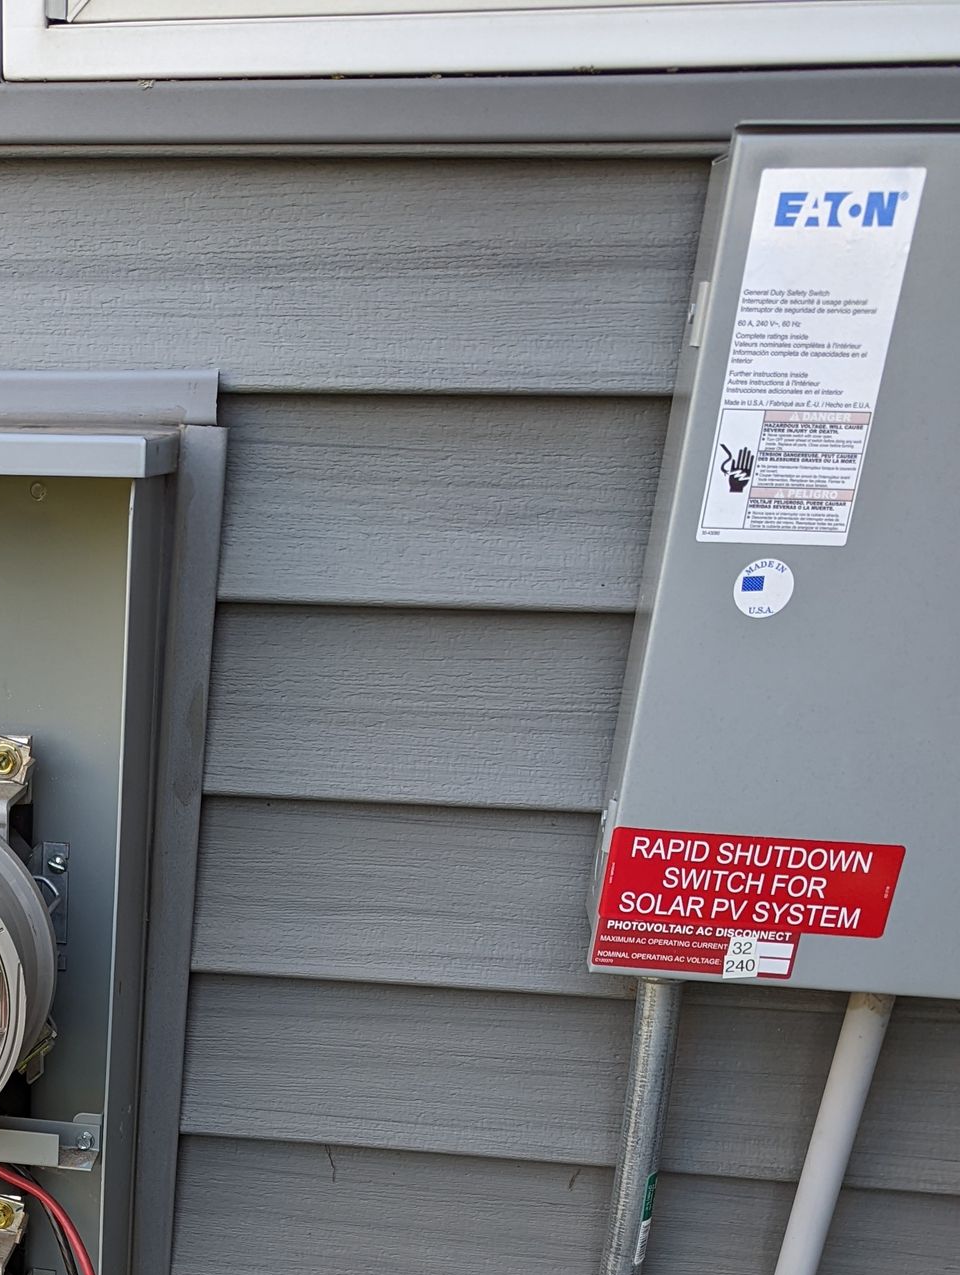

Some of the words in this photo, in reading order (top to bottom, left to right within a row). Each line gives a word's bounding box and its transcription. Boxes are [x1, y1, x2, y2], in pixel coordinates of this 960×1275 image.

[803, 413, 852, 422] DANGER
[787, 490, 837, 498] PELIGRO
[745, 561, 774, 575] MADE
[776, 563, 787, 573] IN
[632, 836, 710, 862] RAPID
[717, 842, 872, 873] SHUTDOWN
[662, 868, 762, 894] SWITCH
[771, 874, 827, 898] FOR
[619, 892, 704, 916] SOLAR
[711, 898, 748, 920] PV
[752, 902, 861, 929] SYSTEM
[607, 920, 694, 934] PHOTOVOLTAIC
[696, 927, 713, 936] AC
[716, 928, 792, 940] DISCONNECT
[600, 935, 635, 943] MAXIMUM
[648, 938, 690, 947] OPERATING
[732, 942, 752, 954] 32
[631, 953, 673, 961] OPERATING
[687, 956, 722, 965] VOLTAGE:
[726, 959, 755, 972] 240
